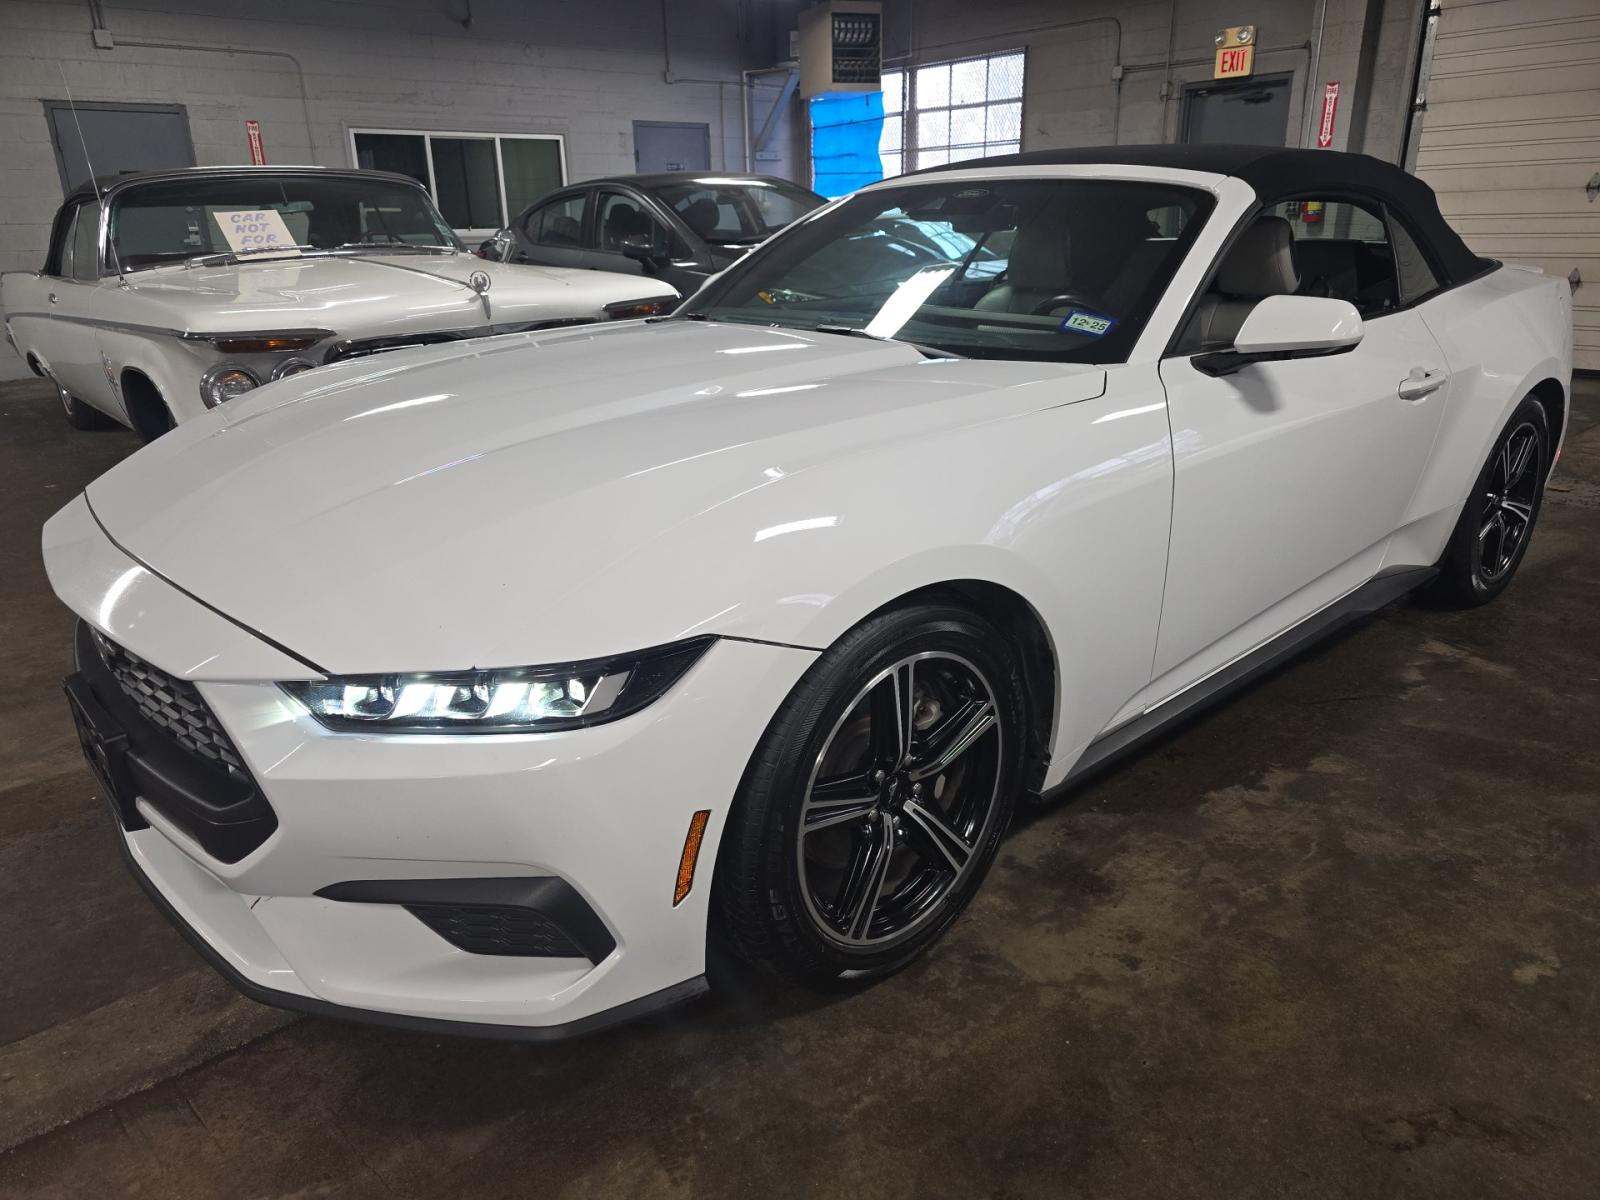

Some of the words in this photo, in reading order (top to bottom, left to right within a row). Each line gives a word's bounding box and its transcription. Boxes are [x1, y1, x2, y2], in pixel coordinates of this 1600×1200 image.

[1221, 49, 1248, 73] EXIT
[230, 213, 266, 224] CAR
[235, 223, 270, 234] NOT
[241, 234, 277, 245] FOR
